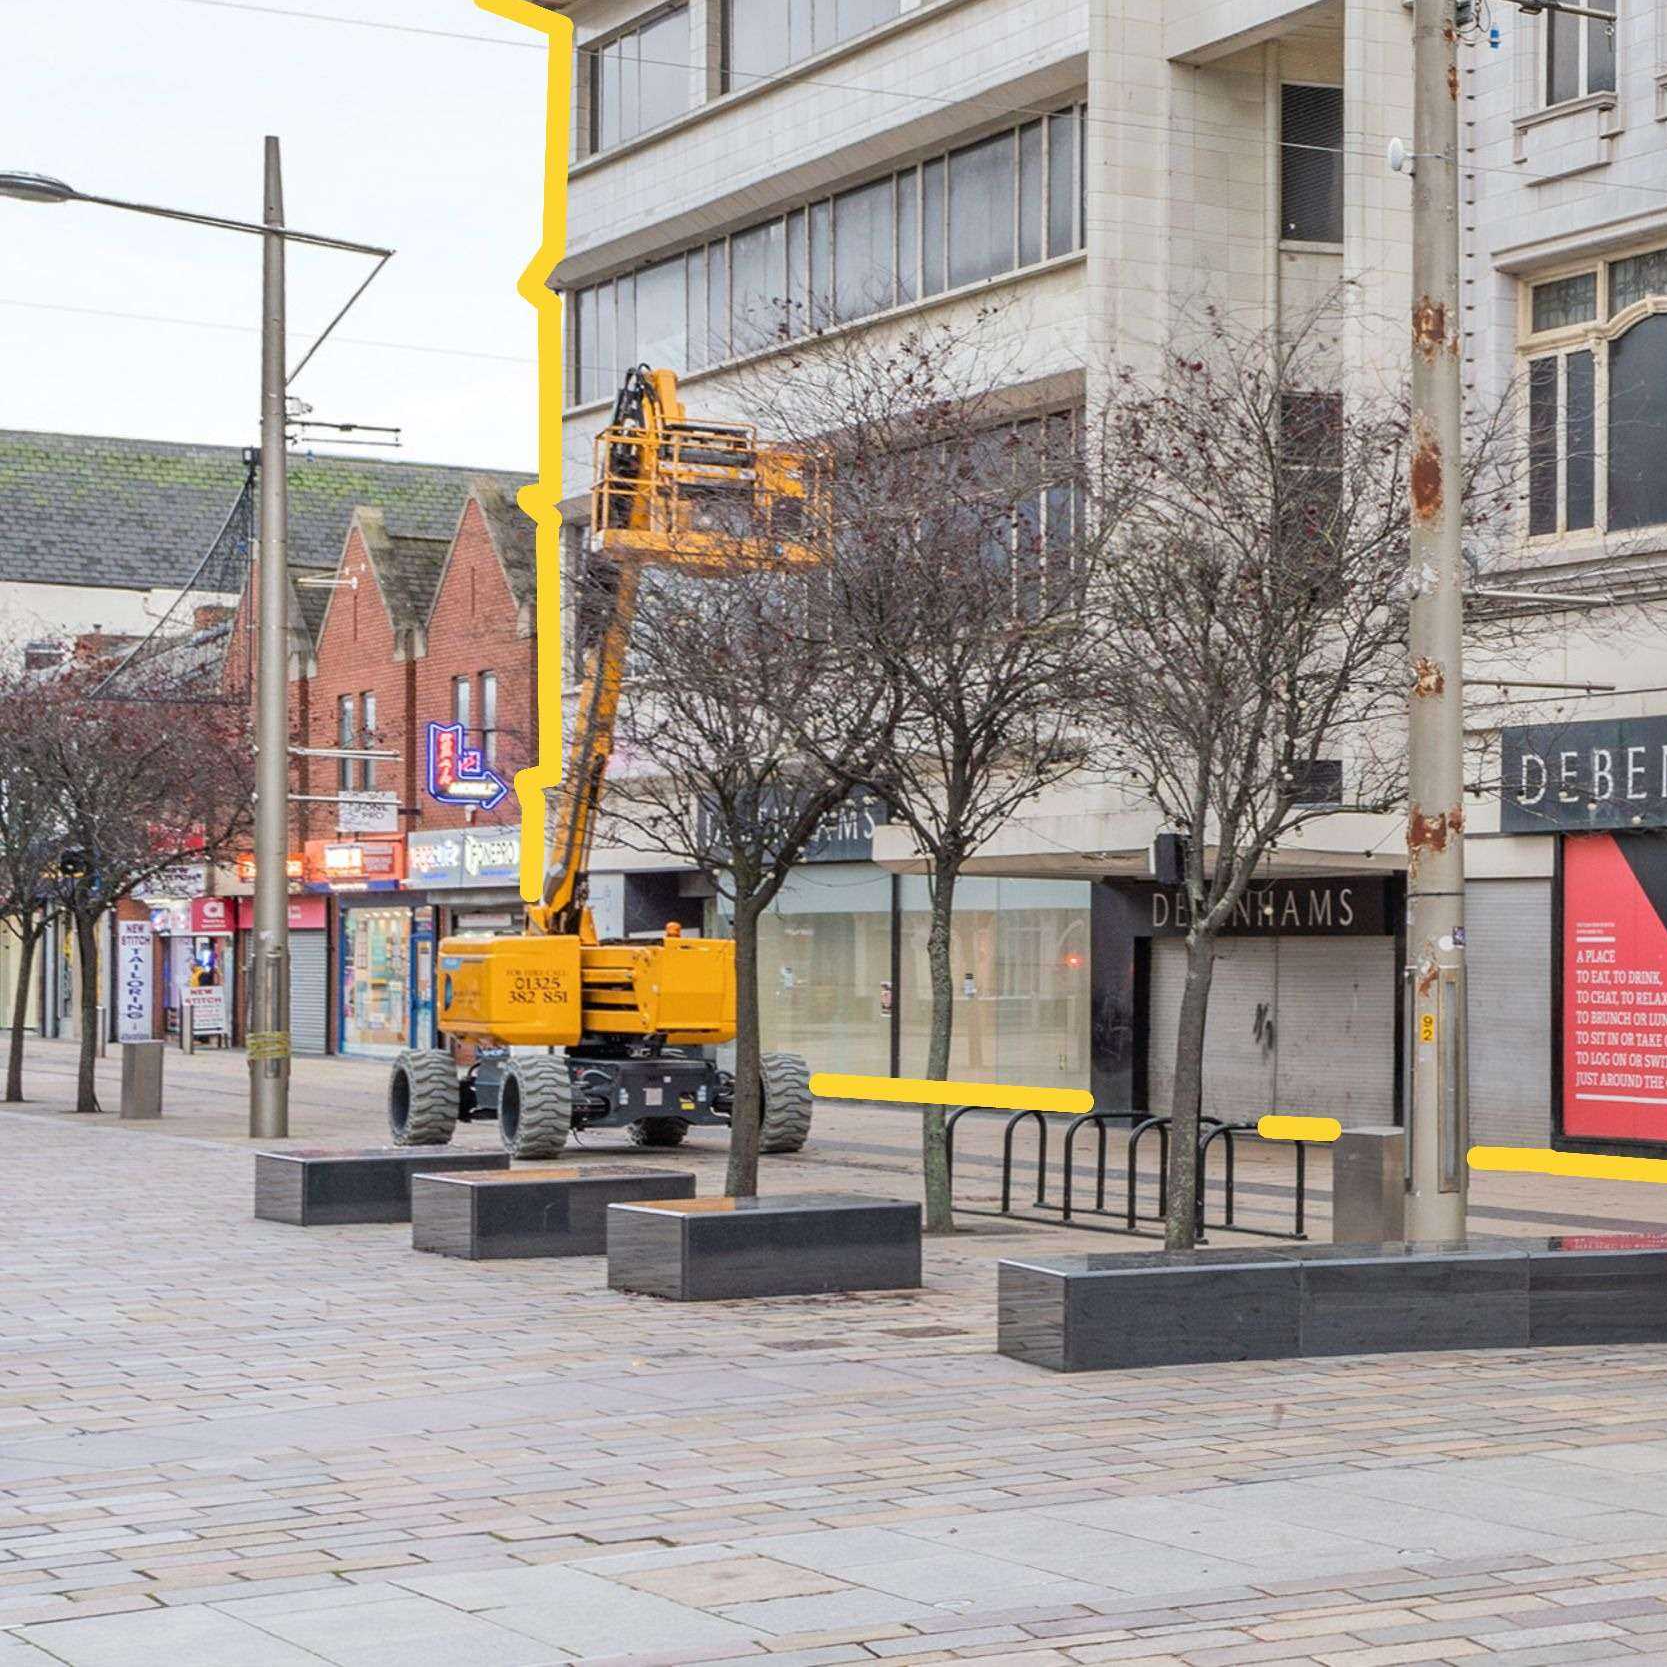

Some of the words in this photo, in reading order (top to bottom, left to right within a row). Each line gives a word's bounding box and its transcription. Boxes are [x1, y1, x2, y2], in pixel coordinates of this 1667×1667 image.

[1152, 888, 1355, 927] DENHAMS
[126, 924, 144, 934] NEW
[1576, 950, 1584, 963] A
[1586, 950, 1616, 963] PLACE
[514, 977, 561, 990] 01325
[1576, 970, 1589, 984] TO
[1591, 970, 1612, 985] EAT,
[1613, 971, 1627, 985] TO
[1628, 971, 1663, 986] DRINK,
[508, 990, 536, 1004] 382
[543, 990, 568, 1004] 851
[1576, 990, 1589, 1004] TO
[1591, 991, 1620, 1006] CHAT,
[1621, 991, 1634, 1005] TO
[1576, 1011, 1589, 1024] TO
[1591, 1011, 1632, 1026] BRUNCH
[1633, 1012, 1647, 1026] OR
[1576, 1031, 1589, 1045] TO
[1591, 1031, 1607, 1045] SIT
[1607, 1032, 1619, 1046] IN
[1620, 1032, 1634, 1046] OR
[1635, 1033, 1662, 1047] TAKE
[1576, 1051, 1589, 1065] TO
[1591, 1052, 1610, 1066] LOG
[1612, 1052, 1627, 1067] ON
[1628, 1053, 1642, 1067] OR
[1576, 1071, 1599, 1087] JUST
[1600, 1073, 1642, 1088] AROUND
[1643, 1074, 1664, 1089] THE
